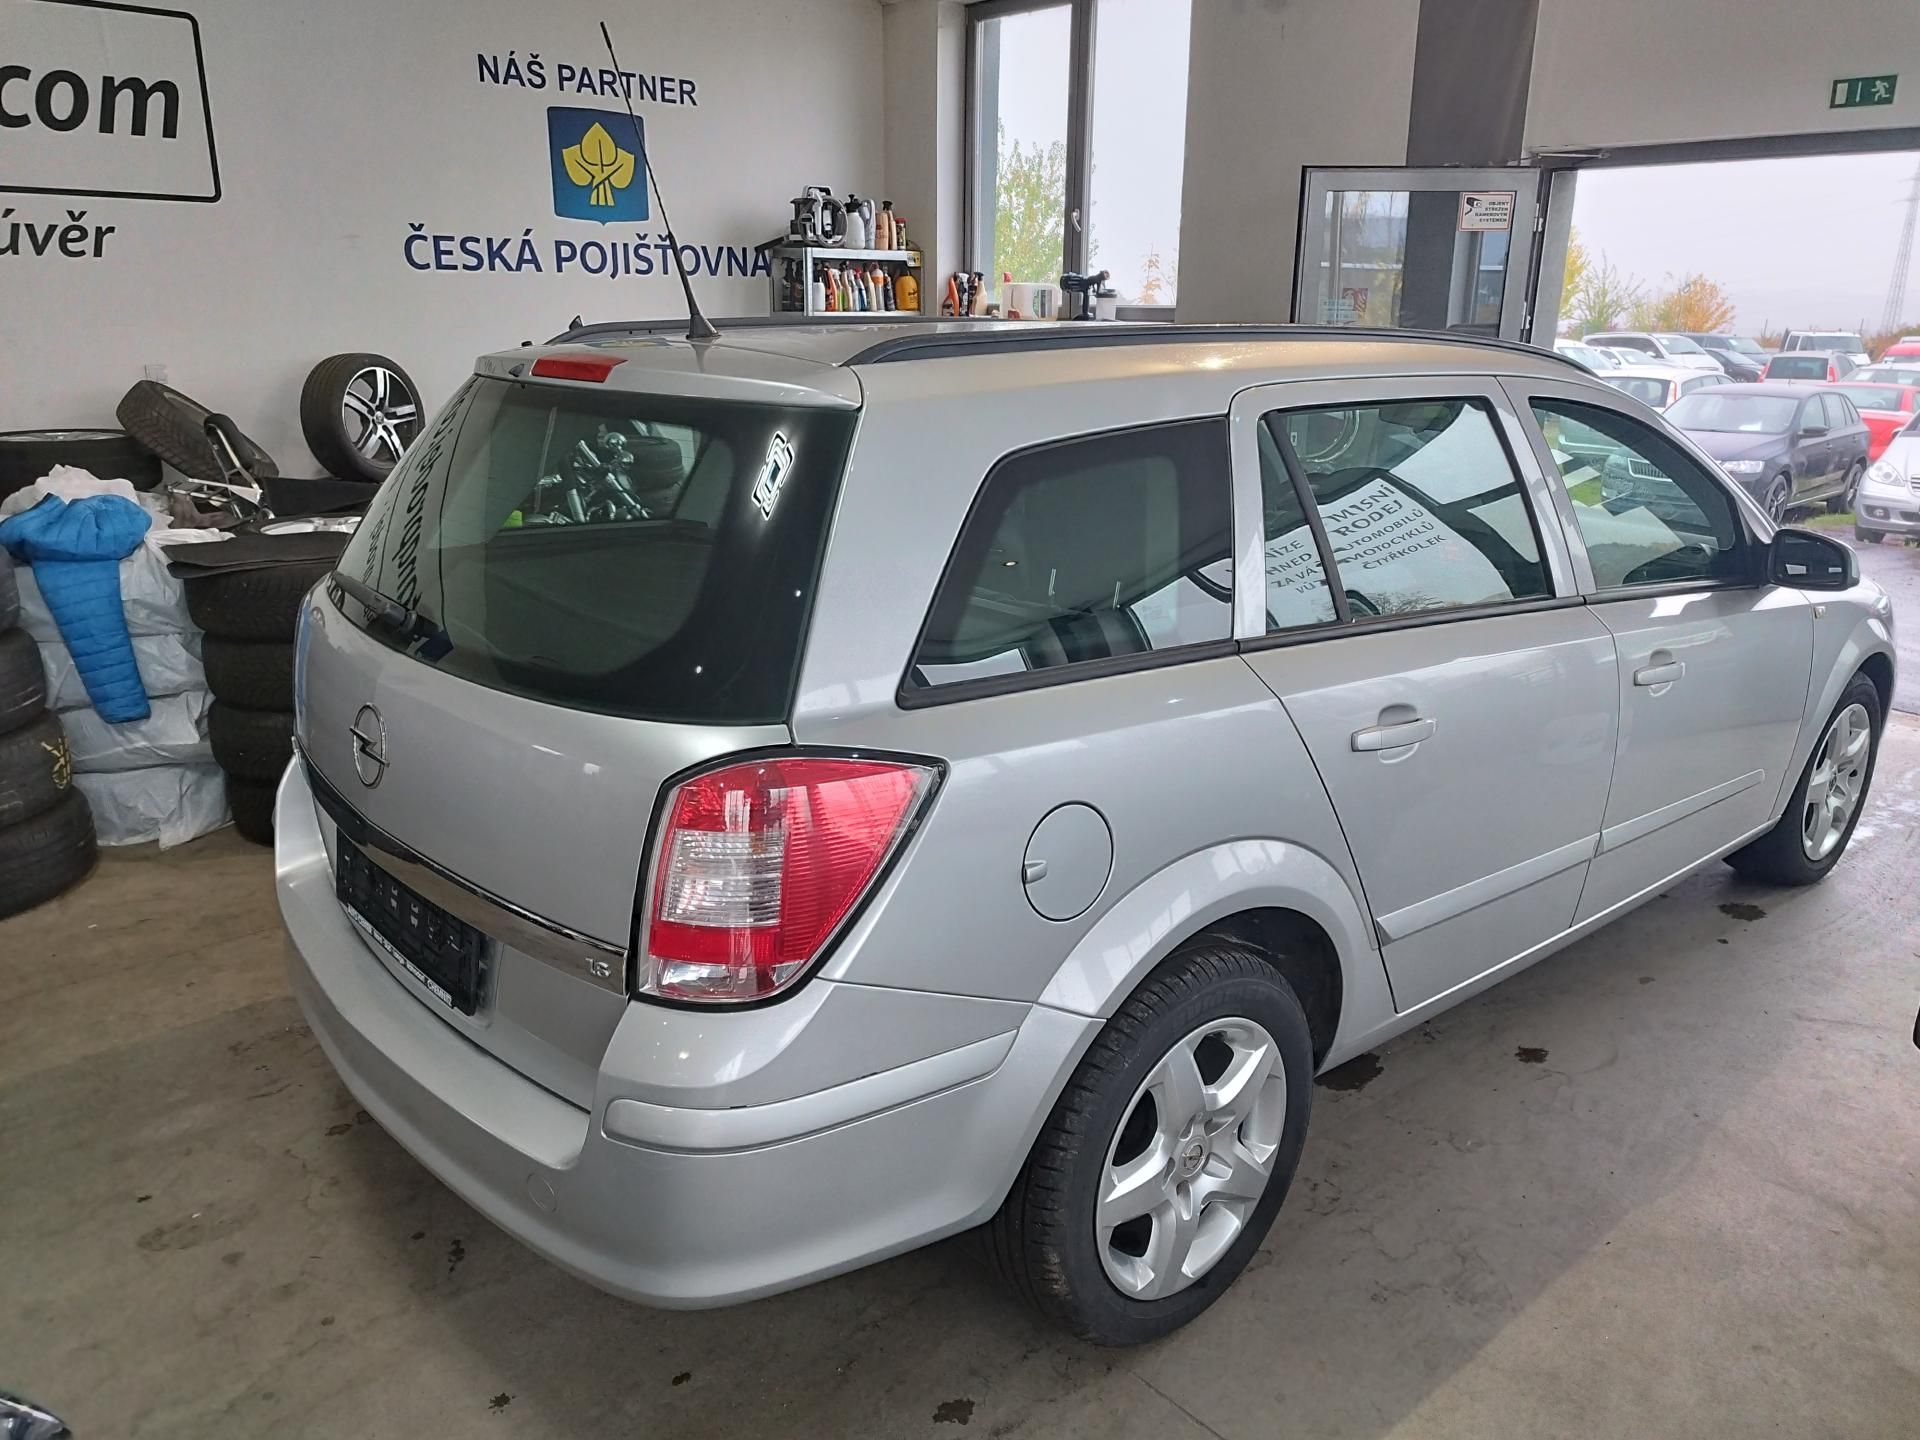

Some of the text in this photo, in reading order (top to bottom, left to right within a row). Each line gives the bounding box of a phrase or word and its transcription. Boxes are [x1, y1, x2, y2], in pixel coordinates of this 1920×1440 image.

[477, 51, 698, 106] NÁŠ PARTNER
[403, 222, 772, 280] ČESKÁ POJIŠŤOVNA
[1362, 534, 1446, 570] ČTYŘKOLEK
[1271, 577, 1296, 588] ZA
